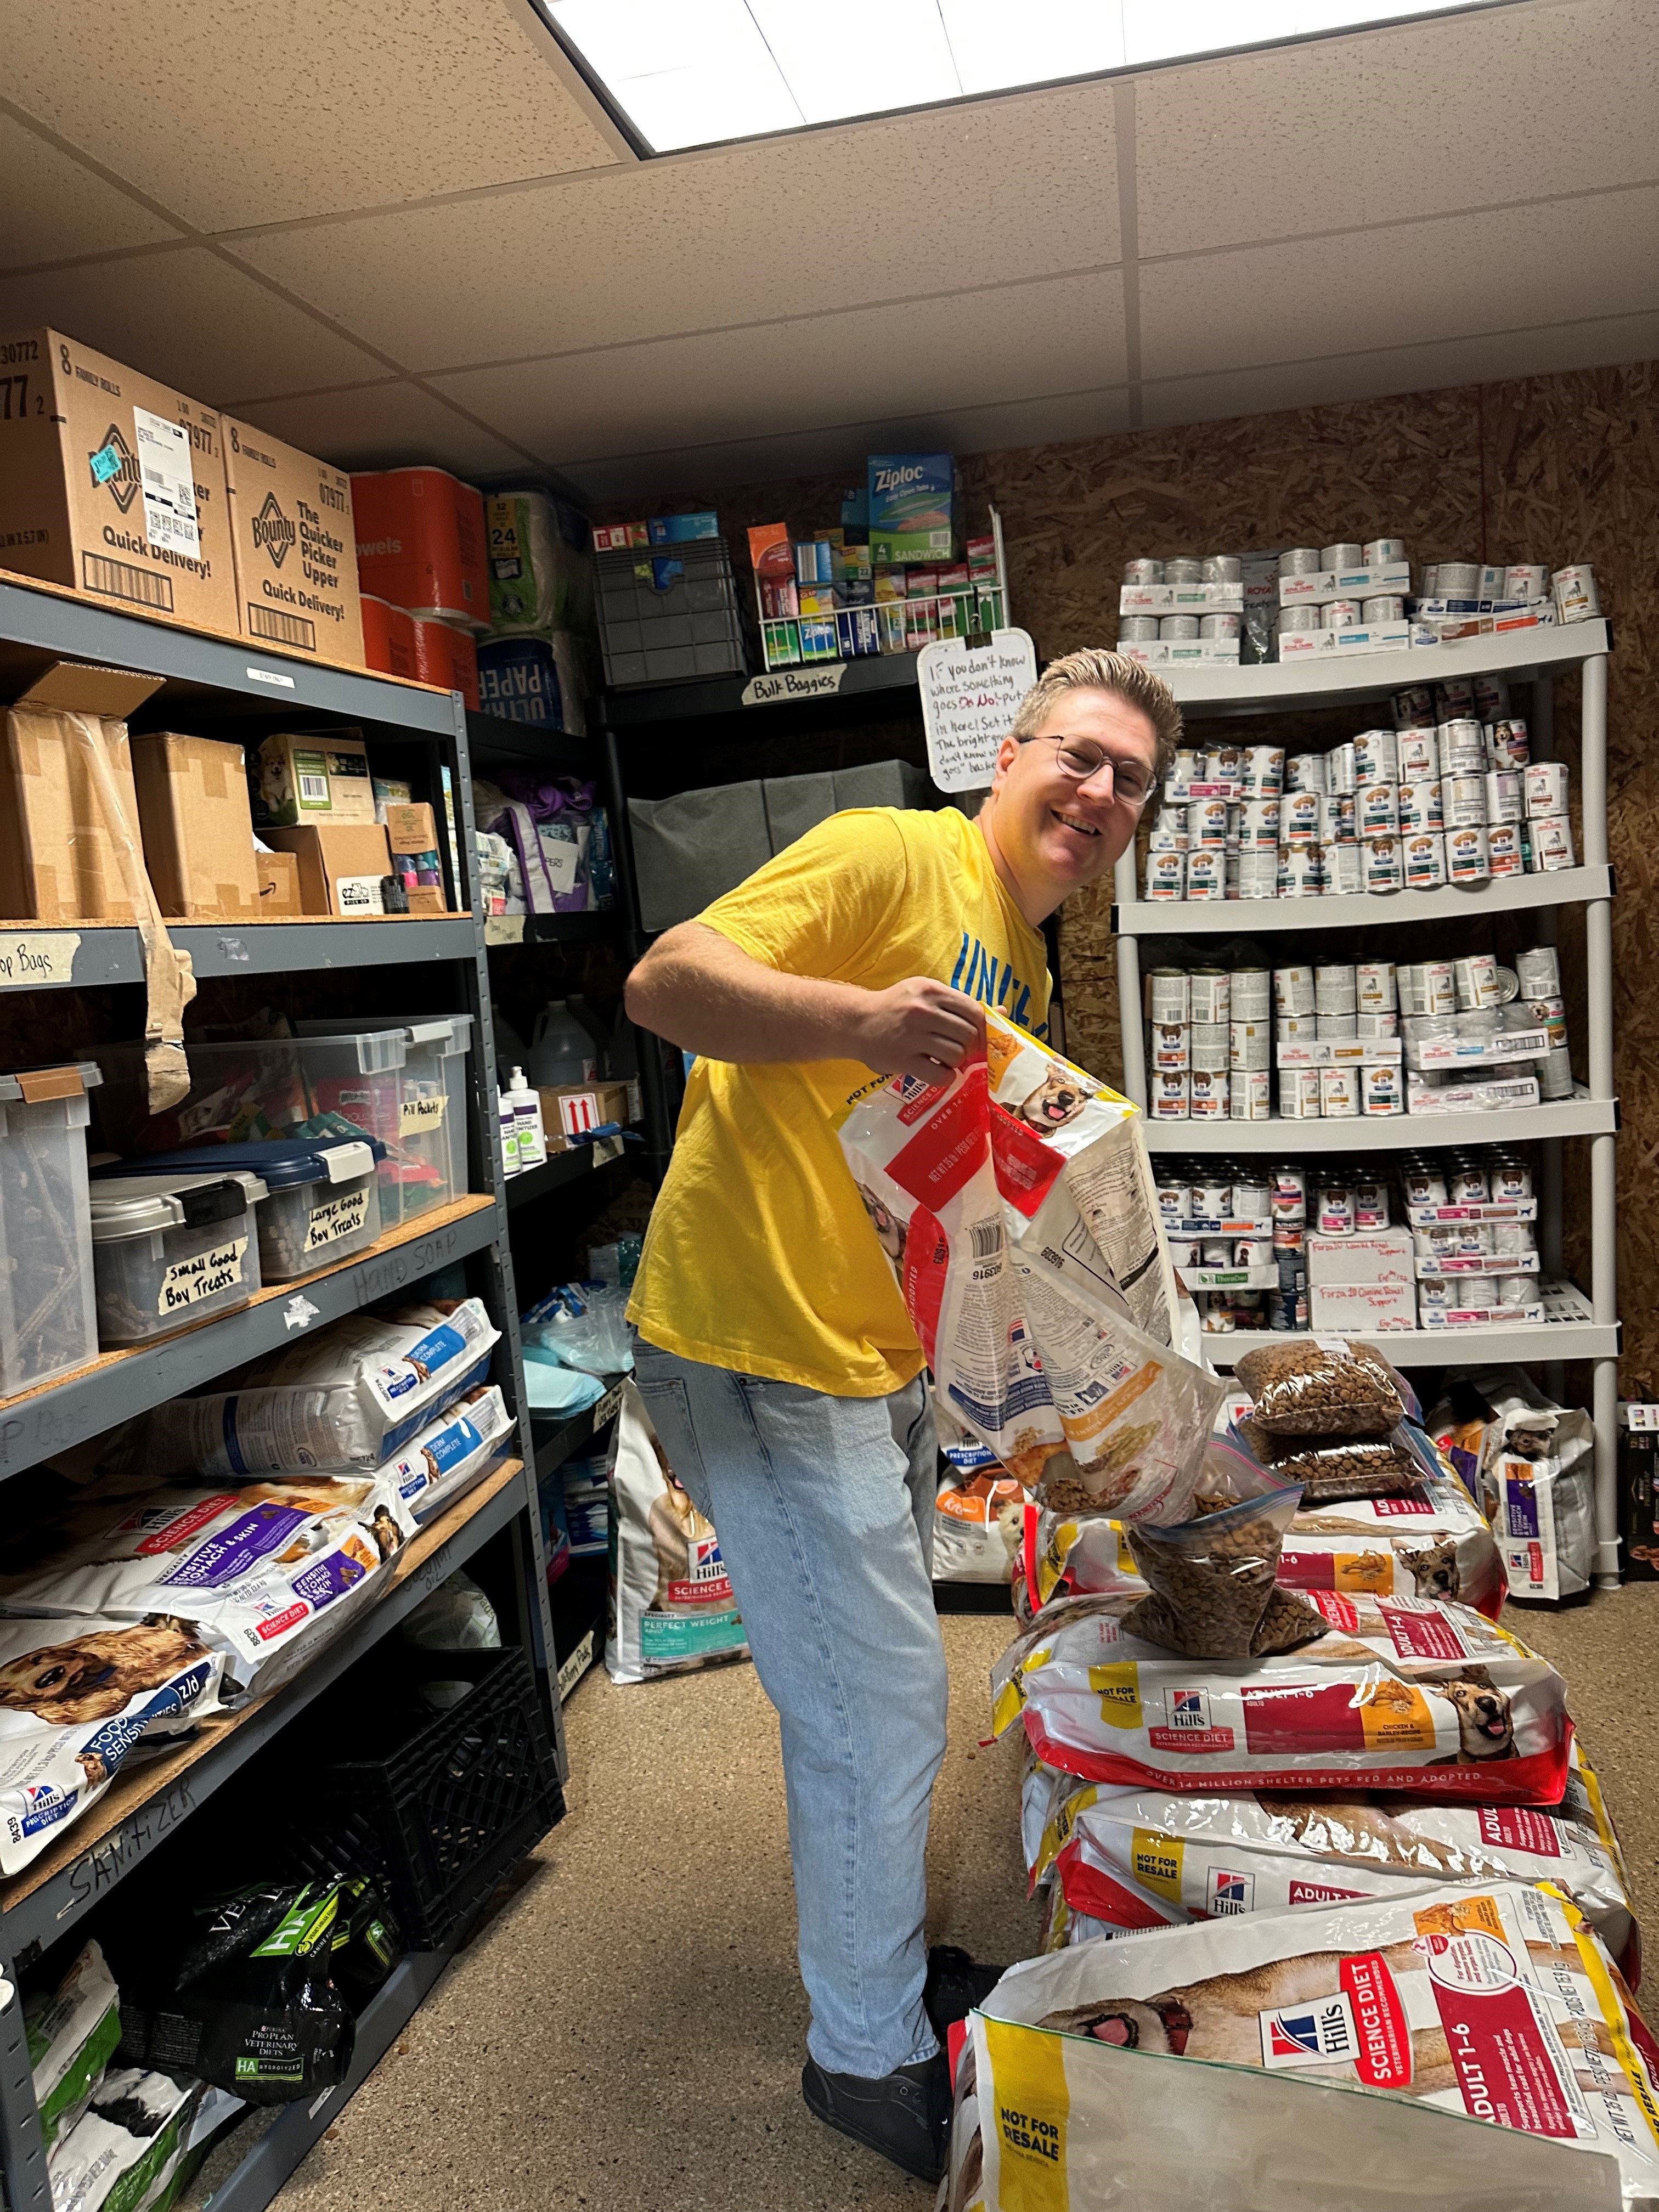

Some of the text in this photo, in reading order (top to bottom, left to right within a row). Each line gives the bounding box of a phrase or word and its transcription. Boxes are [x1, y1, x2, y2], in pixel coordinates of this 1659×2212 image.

[60, 344, 71, 375] 8
[232, 427, 239, 453] 8
[875, 465, 924, 492] Ziploc
[297, 500, 319, 524] The
[496, 503, 506, 511] 12
[103, 526, 148, 556] Quick
[252, 517, 296, 548] Bounty
[300, 523, 343, 553] Quicker
[493, 528, 516, 545] 24
[301, 541, 336, 569] Picker
[878, 543, 886, 554] 4
[895, 549, 950, 561] SANDWICH
[303, 562, 338, 588] Upper
[263, 579, 345, 622] Quick Delivery!
[948, 664, 967, 681] you
[968, 656, 996, 672] don't
[999, 656, 1025, 667] know
[753, 680, 783, 699] Bulk
[930, 675, 1014, 698] where something
[933, 699, 957, 719] goes
[17, 944, 53, 978] Bags
[846, 1086, 867, 1105] NOT
[904, 1081, 926, 1101] Hill's
[403, 1102, 415, 1115] Pill
[904, 1093, 932, 1120] SCIENCE
[932, 1108, 953, 1130] OVER
[340, 1194, 364, 1211] Good
[331, 1212, 360, 1237] Treats
[210, 1243, 238, 1268] Good
[194, 1268, 234, 1296] Treats
[909, 1266, 918, 1307] ADOPTED
[420, 1341, 447, 1361] COMPLETE
[430, 1438, 445, 1452] DERM
[436, 1438, 461, 1460] COMPLETE
[950, 1451, 992, 1459] PRESCRIPTION
[144, 1507, 187, 1530] Hill's
[149, 1497, 227, 1549] SCIENCE DIET
[168, 1543, 218, 1585] SENSITIVE
[178, 1522, 258, 1584] STOMACH & SKIN
[155, 1554, 189, 1584] SPECIALTY
[296, 1564, 328, 1589] SENSITIVE
[300, 1571, 332, 1596] STOMACH
[314, 1579, 332, 1598] SKIN
[674, 1582, 722, 1595] SCIENCE
[262, 1605, 304, 1635] SCIENCE DIET
[644, 1615, 729, 1629] PERFECT WEIGHT
[179, 1675, 199, 1699] z/d
[1116, 1686, 1135, 1695] FOR
[1173, 1713, 1205, 1728] Hill's
[91, 1717, 128, 1750] FOOD
[1154, 1732, 1229, 1742] SCIENCE DIET
[1146, 1770, 1176, 1786] OVER
[1199, 1779, 1252, 1788] MILLION
[1258, 1776, 1313, 1785] SHELTER
[1356, 1775, 1380, 1783] FED
[1386, 1774, 1414, 1783] AND
[1420, 1773, 1482, 1782] ADOPTED
[26, 1795, 76, 1828] PRESCRIPTION
[33, 1793, 60, 1810] Hill's
[7, 1817, 21, 1844] 8439
[41, 1813, 59, 1826] DIET
[1136, 1853, 1177, 1868] NOT FOR
[1137, 1864, 1177, 1879] RESALE
[1294, 1887, 1341, 1901] ADULT
[1214, 1899, 1246, 1915] Hill's
[261, 1905, 317, 1952] HA
[1321, 2004, 1350, 2053] Hill's
[1351, 1963, 1391, 2079] SCIENCE DIET
[1371, 1960, 1403, 2075] VETERINARIAN RECOMMENDED
[244, 2039, 300, 2051] VETERINARY
[252, 2031, 295, 2040] PRO PLAN
[1451, 2023, 1476, 2056] 1-6
[259, 2048, 284, 2056] DIETS
[1498, 2048, 1513, 2073] muscle
[238, 2059, 256, 2073] HA
[1508, 2074, 1519, 2090] lean
[1631, 2069, 1658, 2117] RESALE
[1513, 2091, 1531, 2130] Supports
[1523, 2092, 1543, 2129] beautiful
[1609, 2113, 1629, 2127] WT
[1001, 2107, 1058, 2140] NOT FOR
[1003, 2124, 1059, 2161] RESALE
